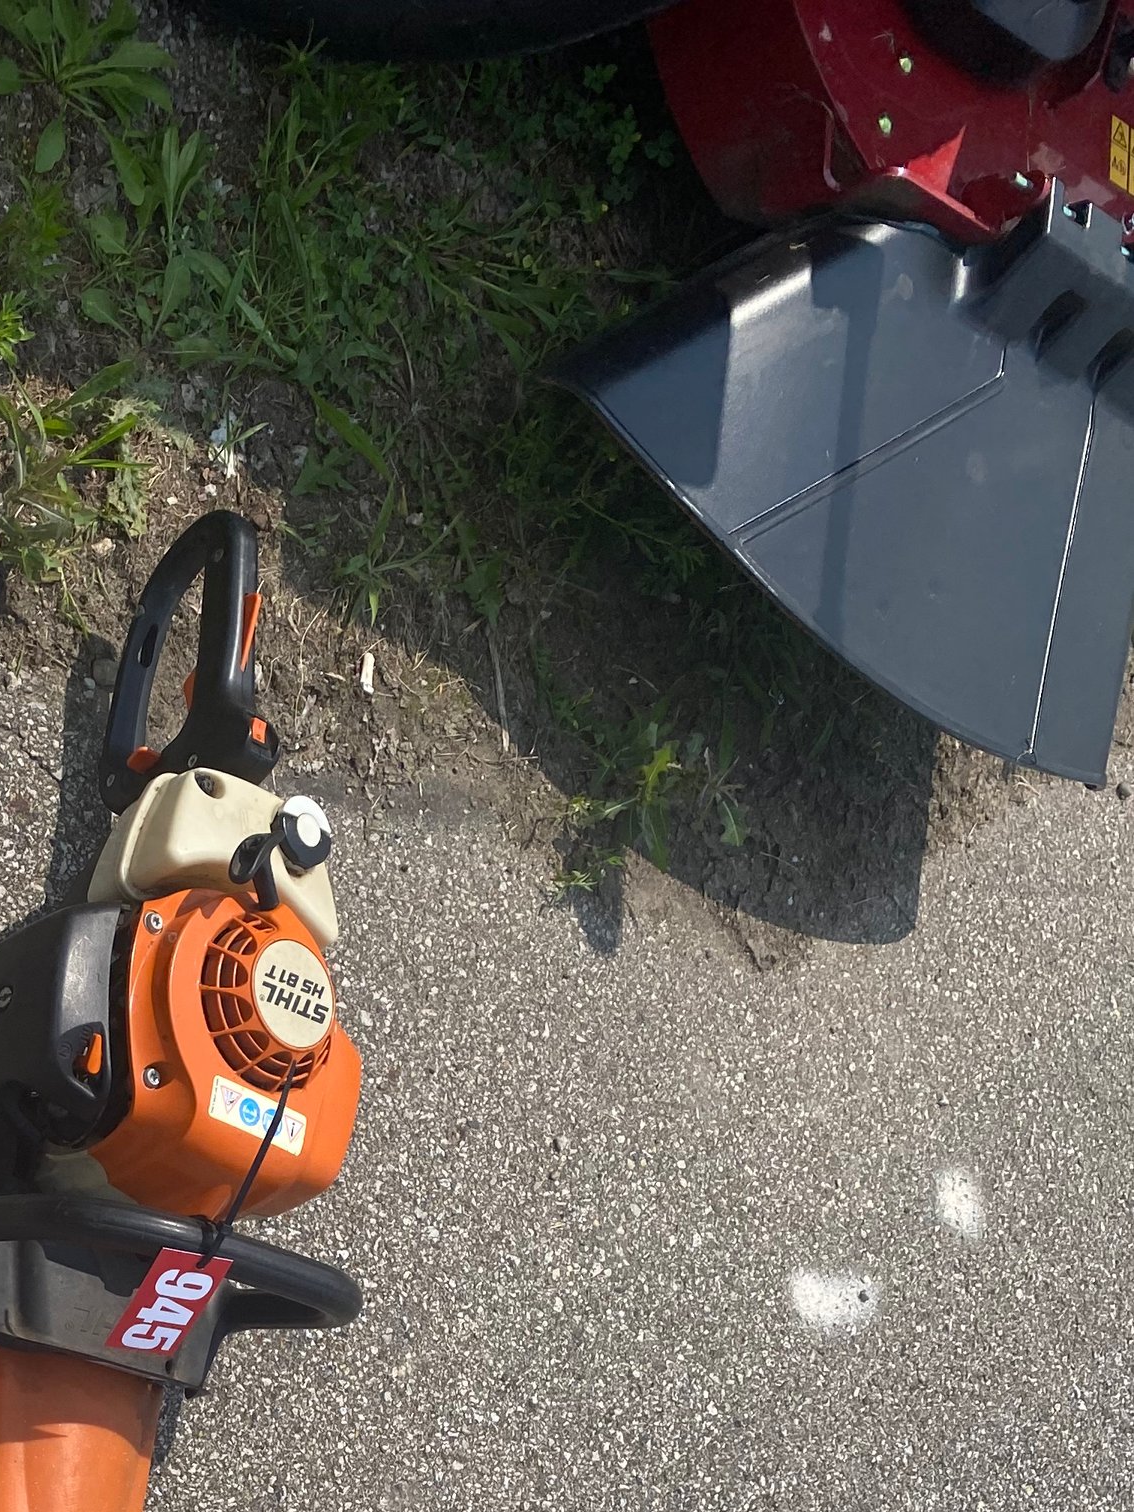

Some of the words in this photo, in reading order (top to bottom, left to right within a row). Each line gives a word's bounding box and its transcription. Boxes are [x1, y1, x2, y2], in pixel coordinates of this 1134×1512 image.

[262, 981, 329, 1024] STIHL
[300, 979, 325, 999] HS
[121, 1269, 213, 1351] 945
